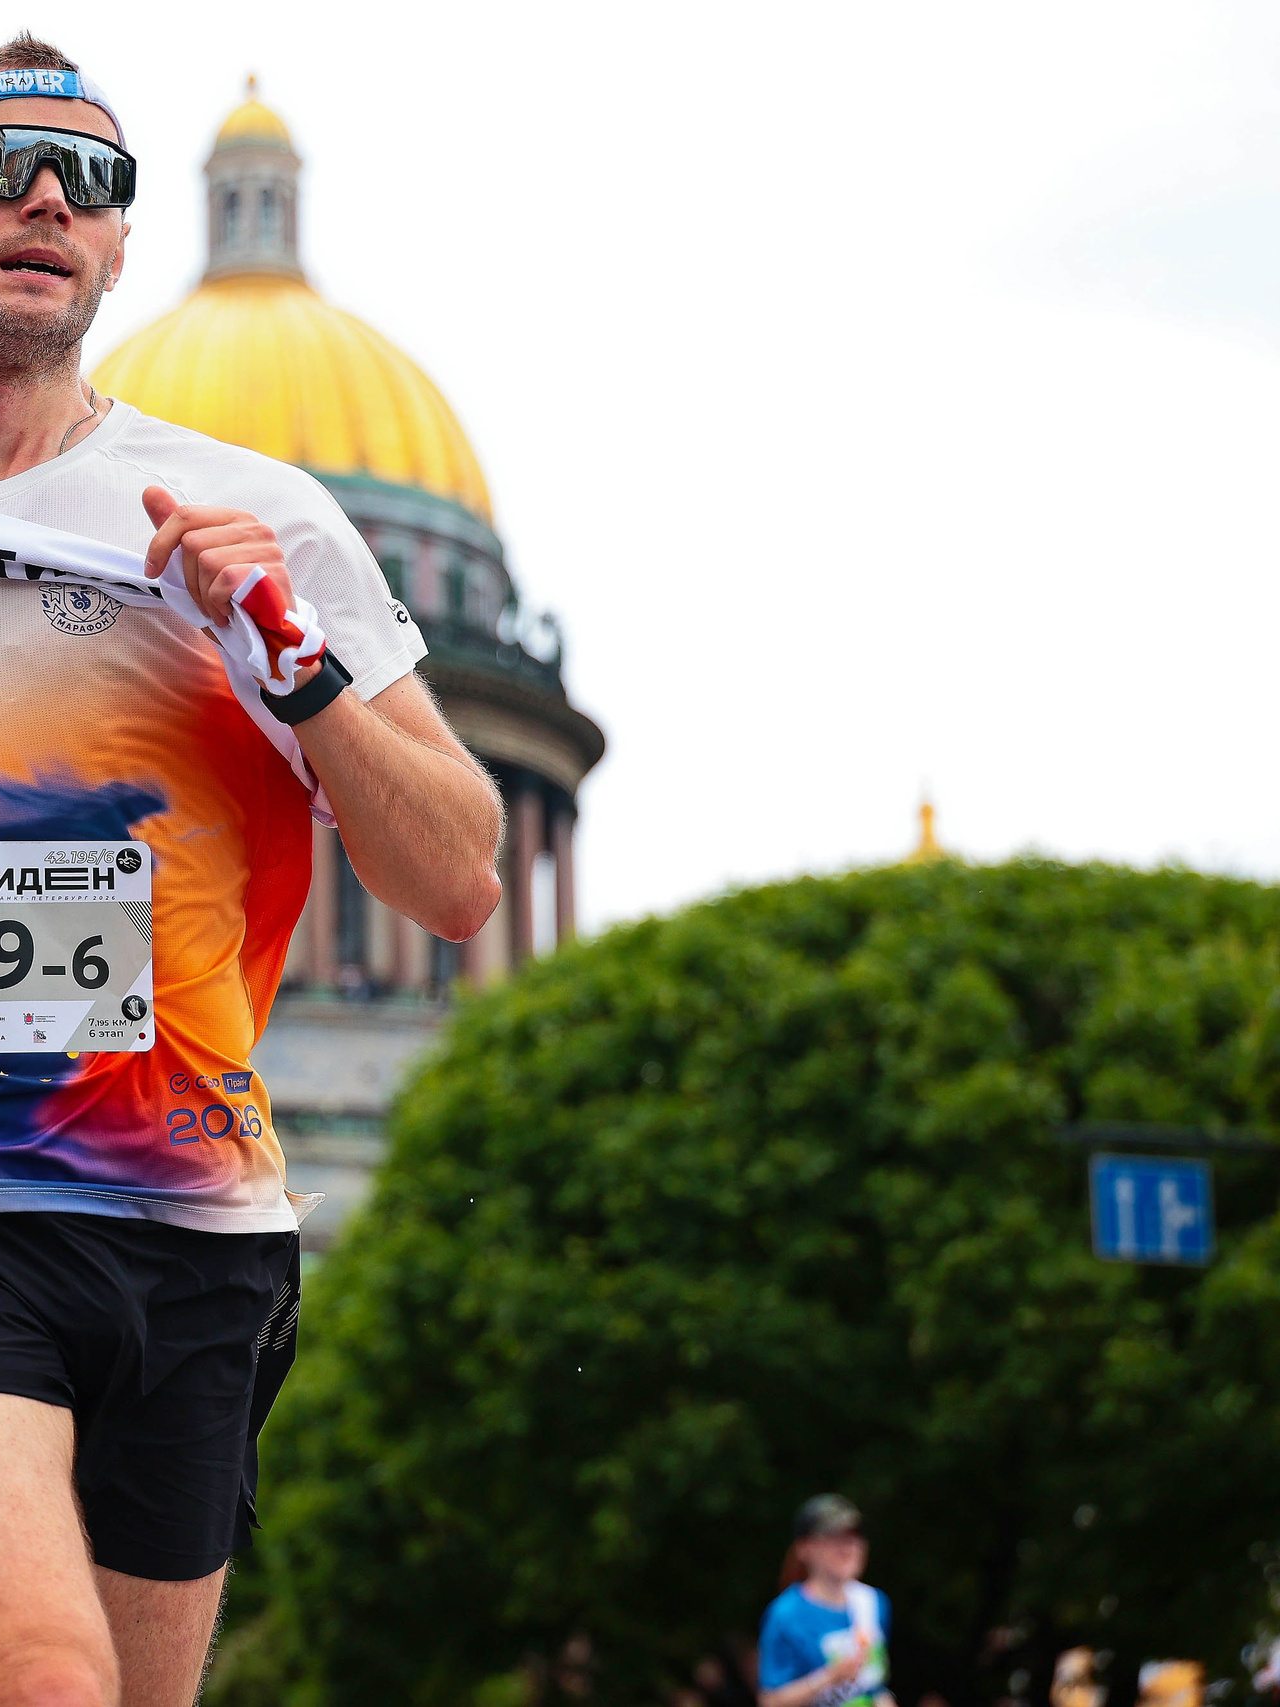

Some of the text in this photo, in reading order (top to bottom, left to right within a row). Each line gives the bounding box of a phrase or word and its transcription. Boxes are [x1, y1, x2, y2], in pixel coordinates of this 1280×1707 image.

[56, 617, 110, 633] МАРАФОН
[44, 849, 115, 865] 42.195/6
[89, 1029, 124, 1038] 6 этап
